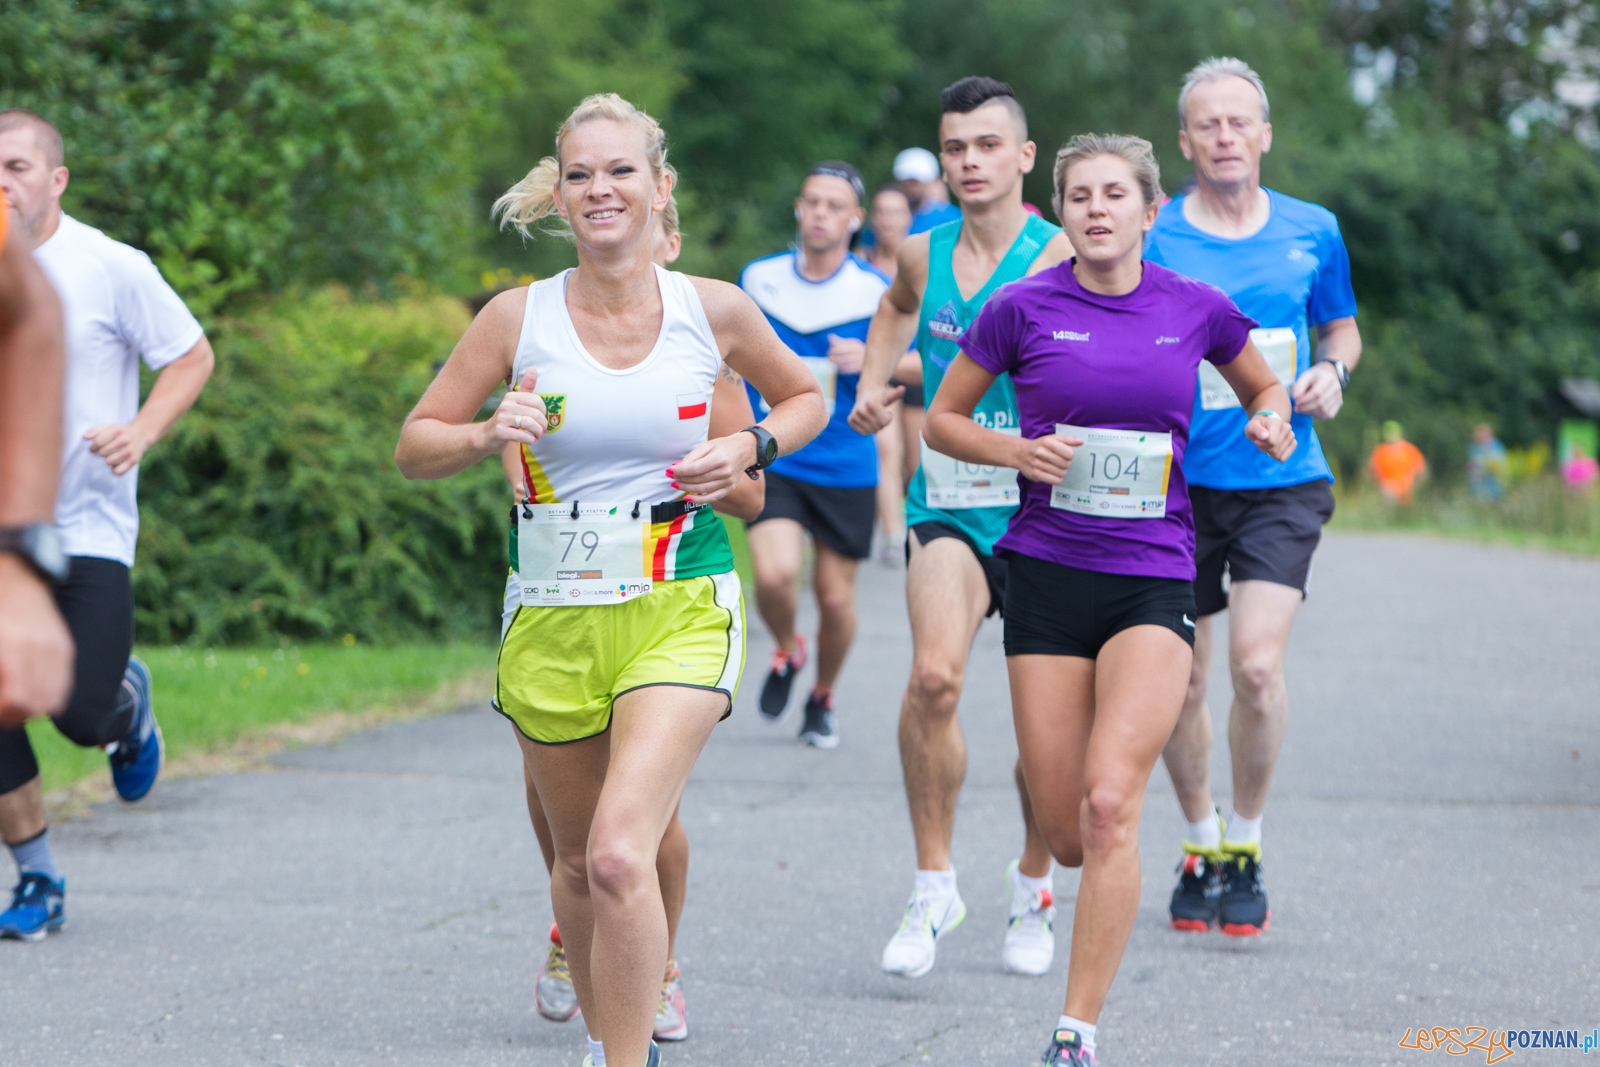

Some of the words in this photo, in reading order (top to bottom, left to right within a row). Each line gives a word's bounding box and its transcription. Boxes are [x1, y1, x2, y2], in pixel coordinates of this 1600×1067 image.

[1090, 452, 1140, 481] 104
[559, 530, 599, 563] 79
[629, 583, 650, 593] mjp
